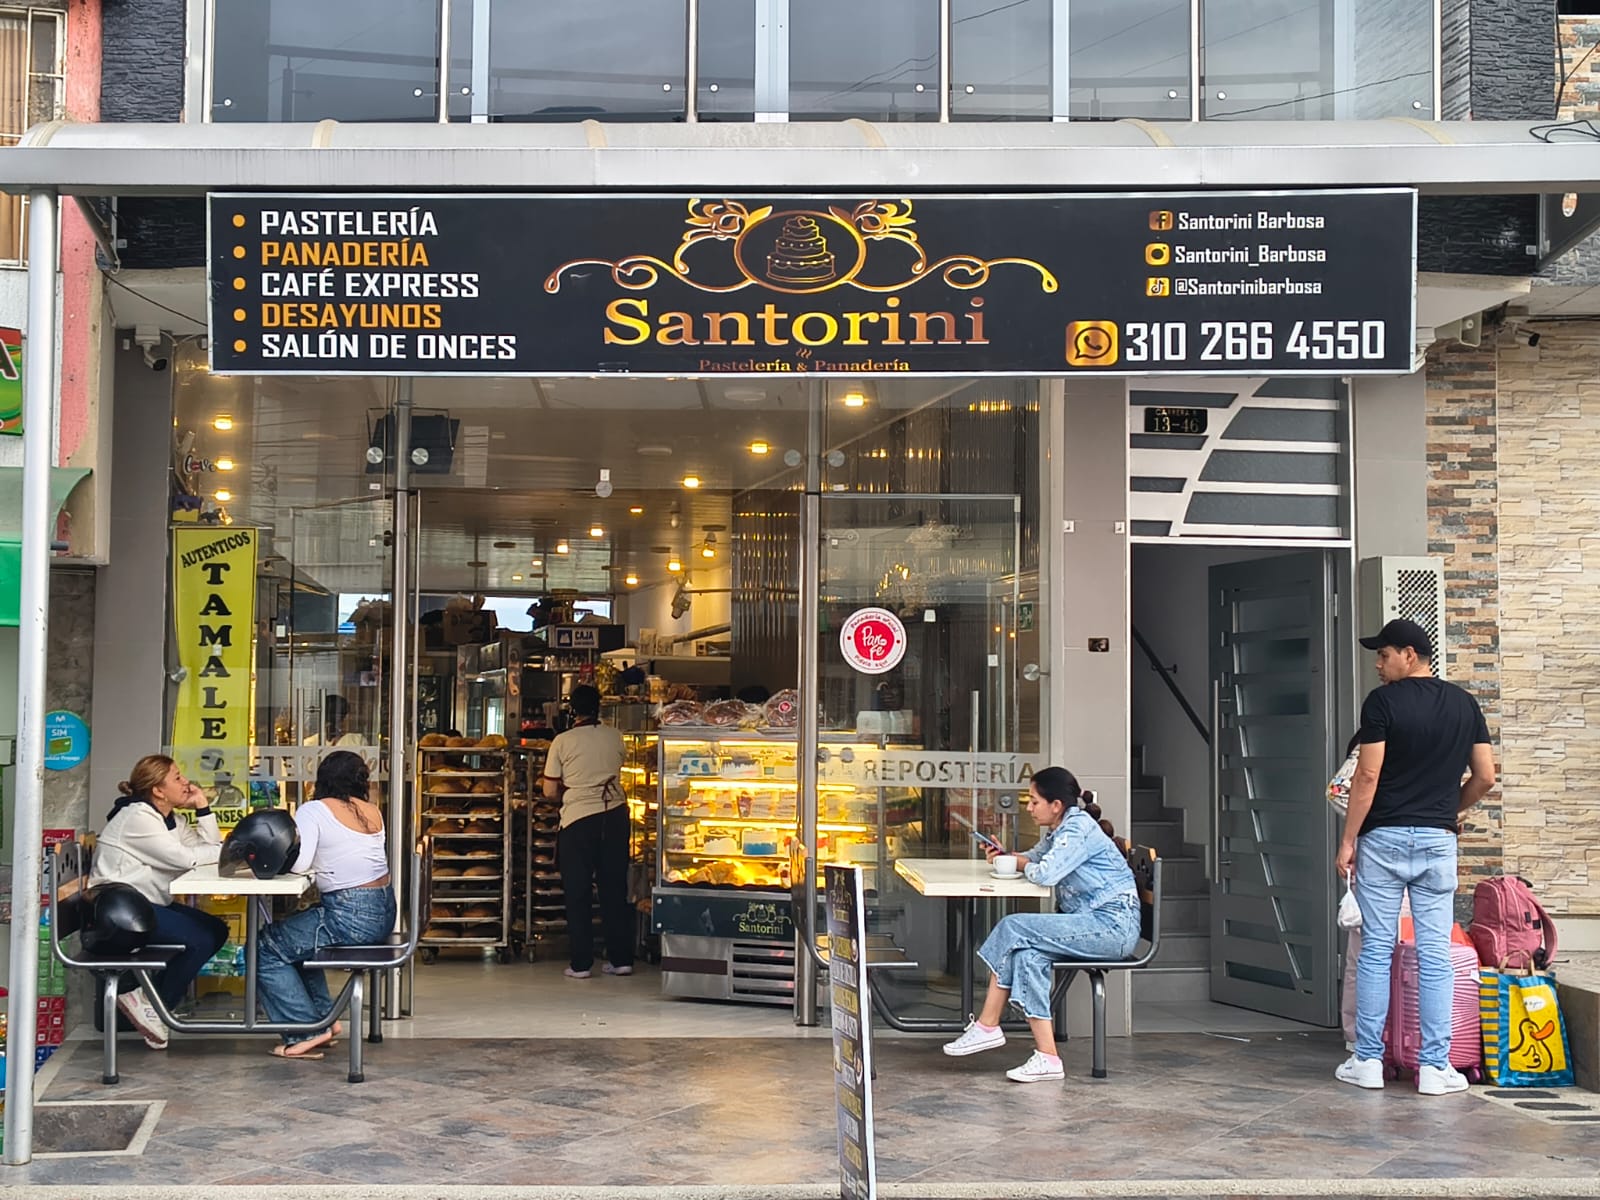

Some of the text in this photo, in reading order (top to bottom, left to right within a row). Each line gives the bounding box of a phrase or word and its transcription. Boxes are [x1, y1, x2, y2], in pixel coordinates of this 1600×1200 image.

[260, 207, 439, 236] PASTELERÍA
[1177, 212, 1325, 230] Santorini Barbosa
[260, 238, 430, 267] PANADERÍA
[1174, 244, 1327, 267] Santorini_Barbosa
[260, 268, 480, 298] CAFÉ EXPRESS
[1174, 278, 1323, 296] @Santorinibarbosa
[261, 303, 442, 329] DESAYUNOS
[603, 296, 990, 346] Santorini
[261, 329, 518, 360] SALÓN DE ONCES
[1125, 320, 1386, 362] 310 266 4550
[699, 358, 911, 372] Pastelería & Panadería
[180, 531, 251, 568] AUTENTICOS
[574, 631, 594, 641] CAJA
[198, 562, 233, 772] TAMALES
[51, 728, 68, 737] SIM
[863, 756, 1034, 785] REPOSTERÍA
[738, 921, 785, 936] Santorini
